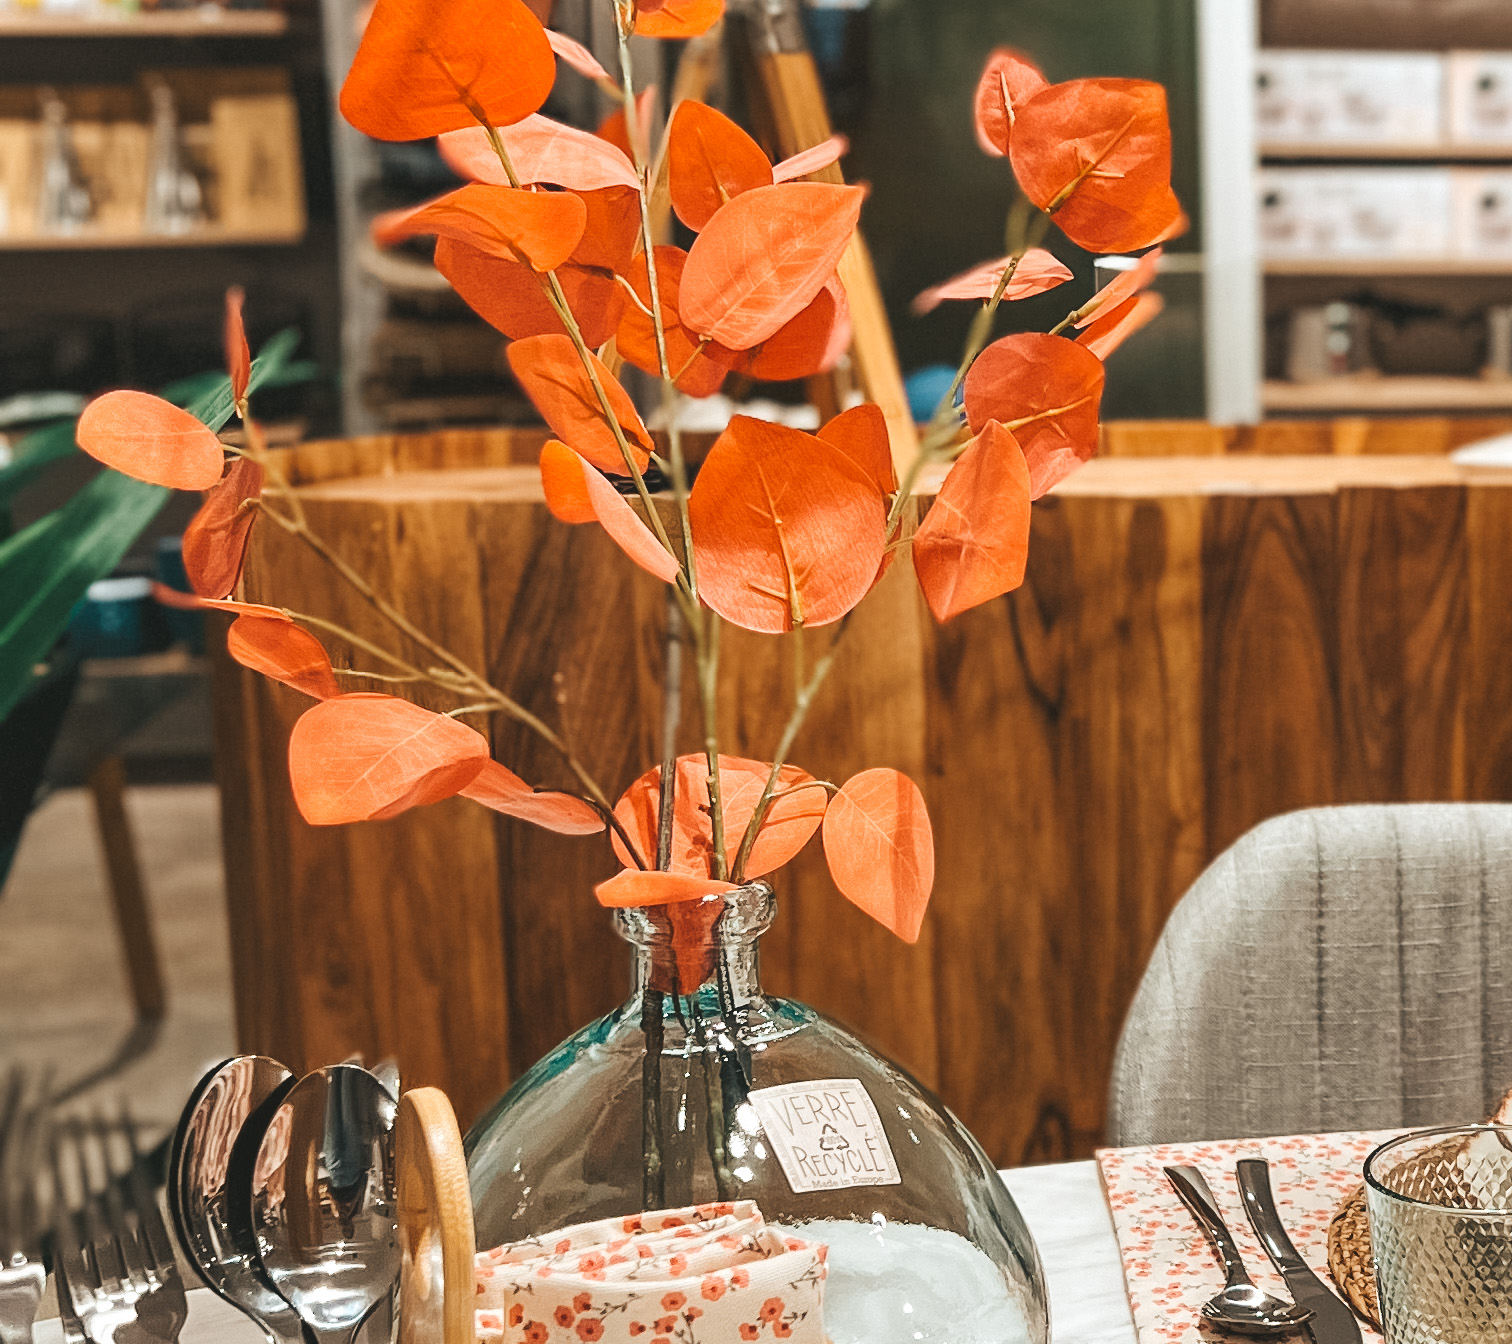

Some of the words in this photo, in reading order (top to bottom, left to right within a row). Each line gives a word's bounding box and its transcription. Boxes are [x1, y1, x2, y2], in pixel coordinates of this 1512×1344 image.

[768, 1090, 867, 1136] VERRE
[812, 1179, 838, 1189] Made
[840, 1177, 850, 1186] in
[851, 1175, 885, 1186] Europe
